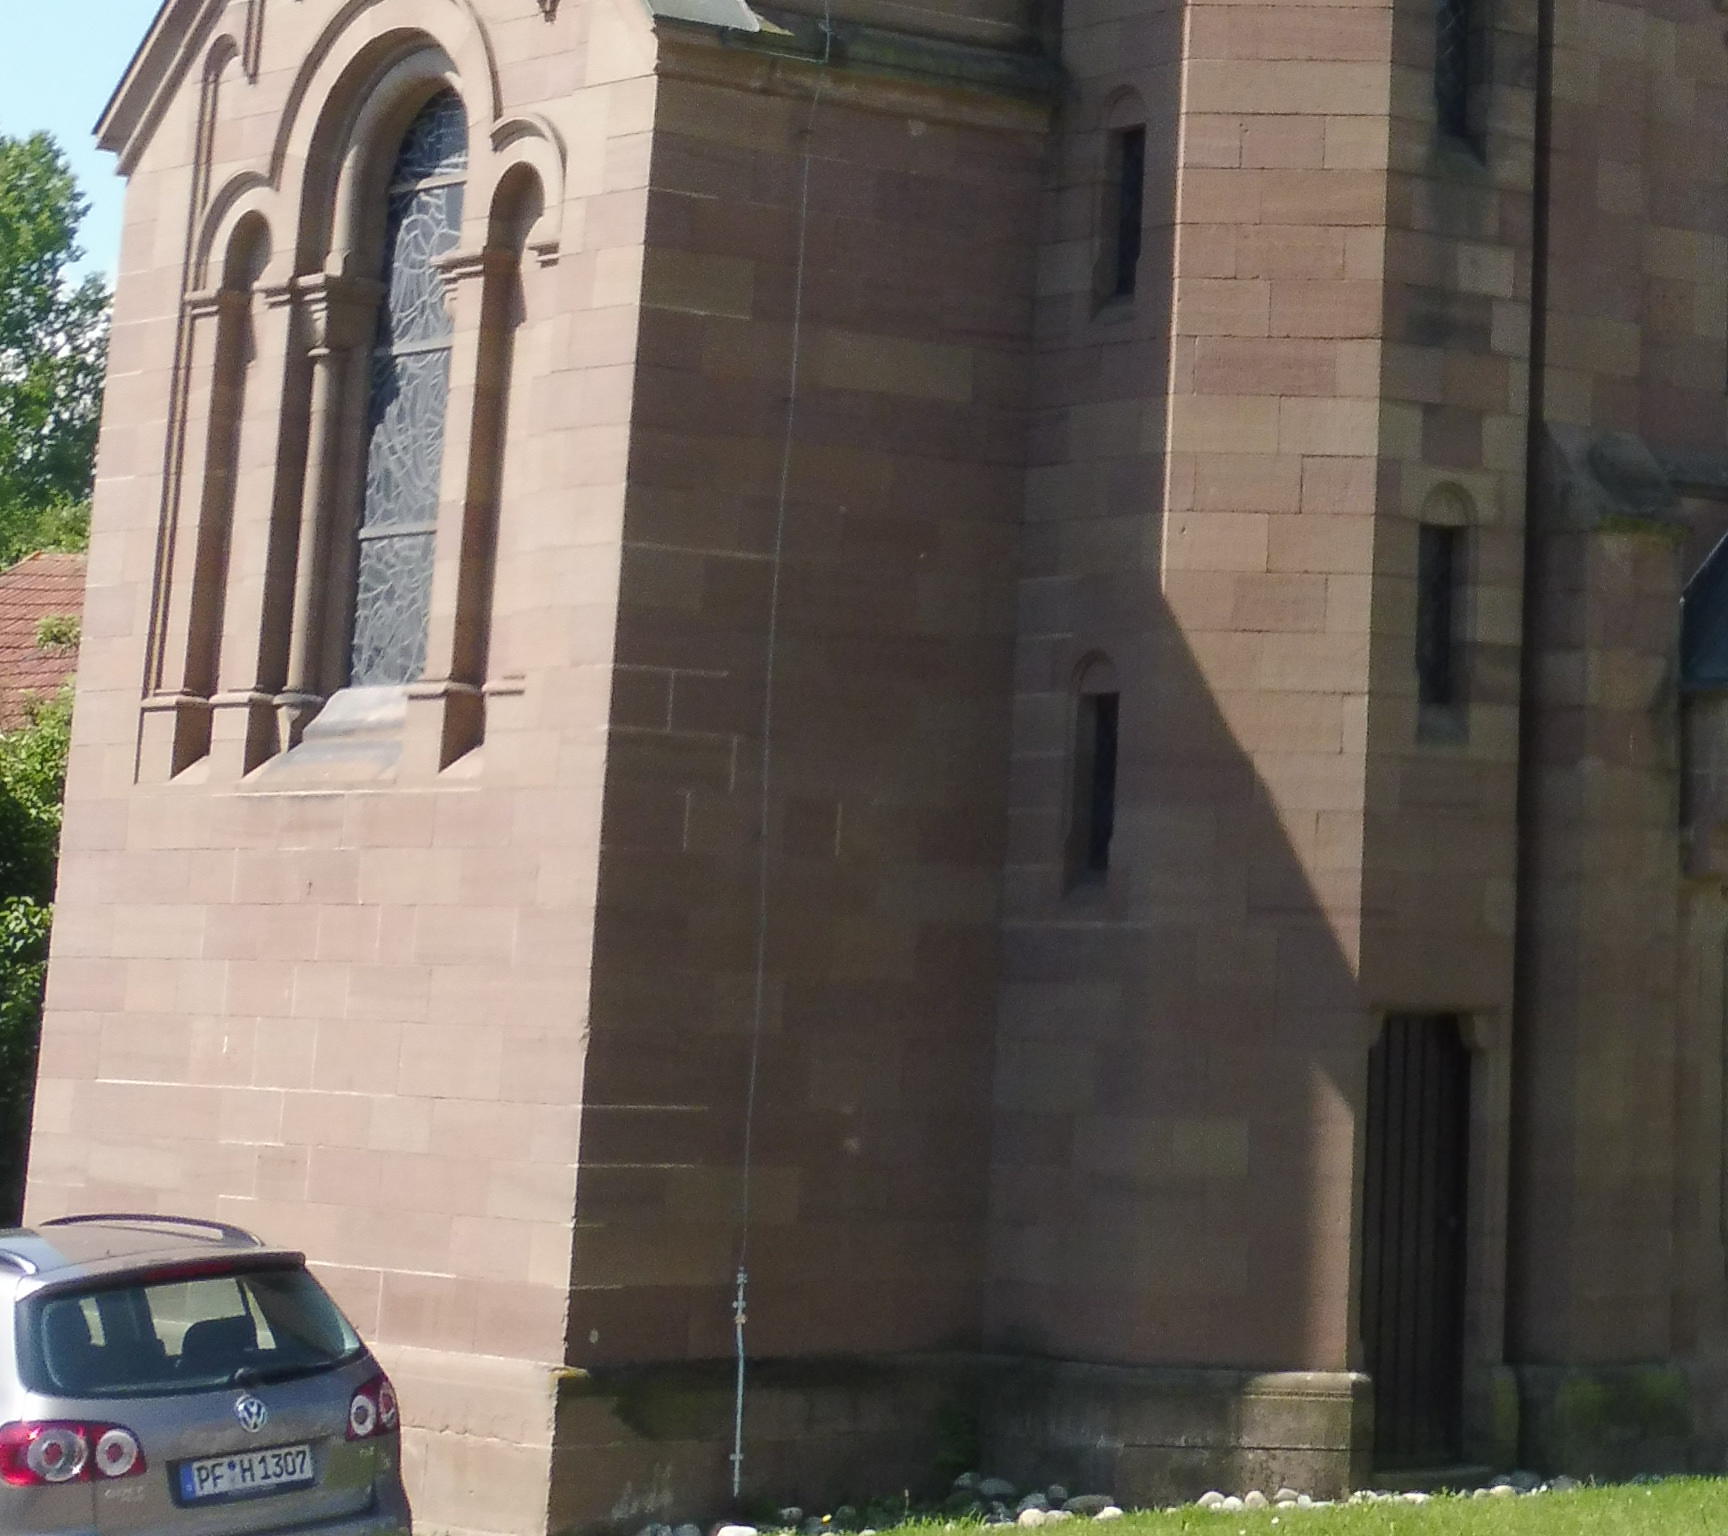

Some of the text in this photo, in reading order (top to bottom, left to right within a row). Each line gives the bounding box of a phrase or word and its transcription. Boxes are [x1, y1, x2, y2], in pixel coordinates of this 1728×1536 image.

[196, 1450, 307, 1490] PF H 1307
